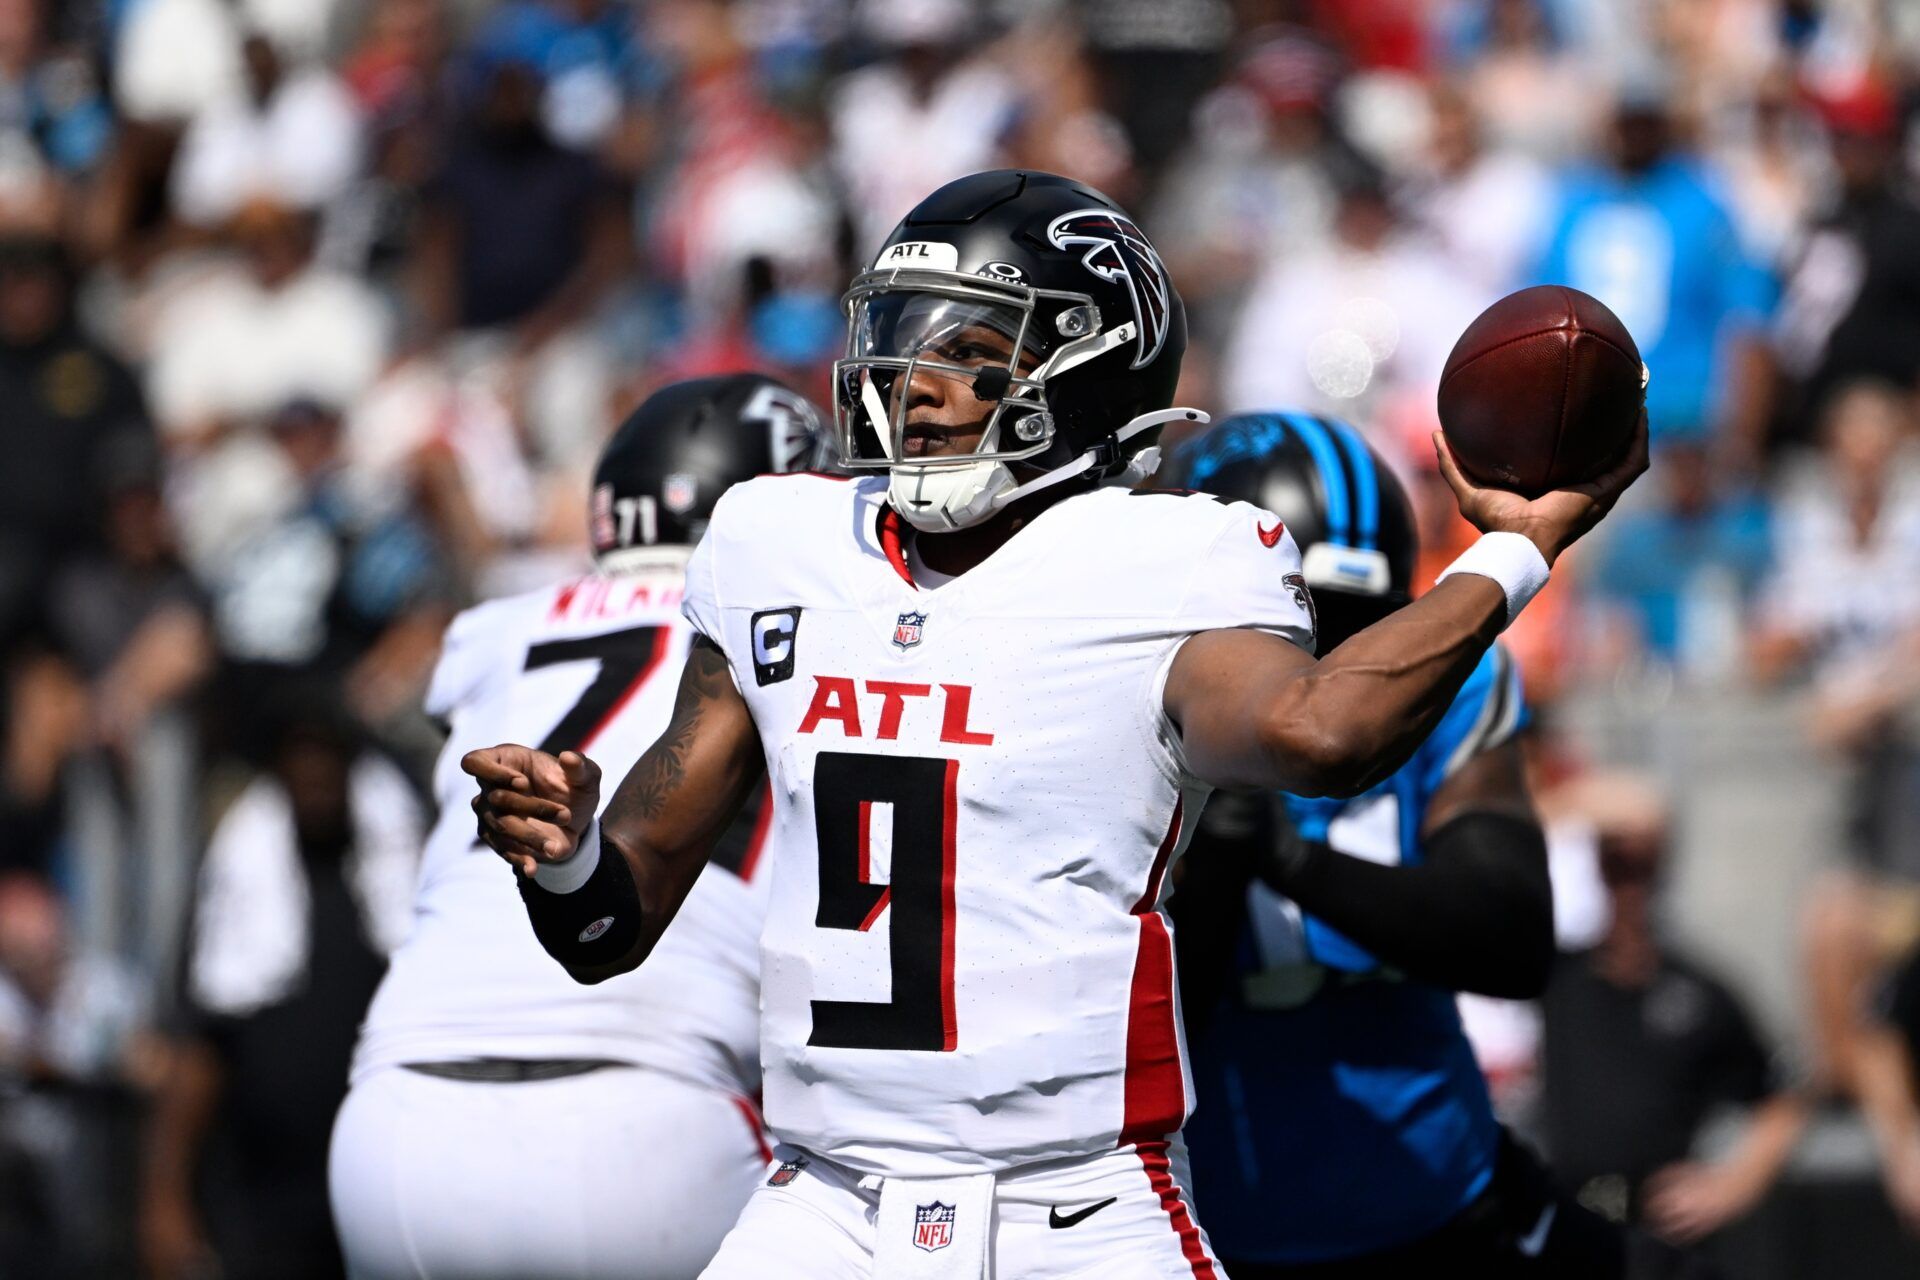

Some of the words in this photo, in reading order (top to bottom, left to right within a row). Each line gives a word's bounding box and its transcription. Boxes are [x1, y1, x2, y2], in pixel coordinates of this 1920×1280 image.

[890, 243, 930, 259] ATL
[614, 495, 658, 546] 71
[754, 613, 795, 666] C
[895, 626, 919, 643] NFL
[797, 675, 994, 746] ATL
[806, 751, 960, 1052] 9
[917, 1224, 948, 1247] NFL
